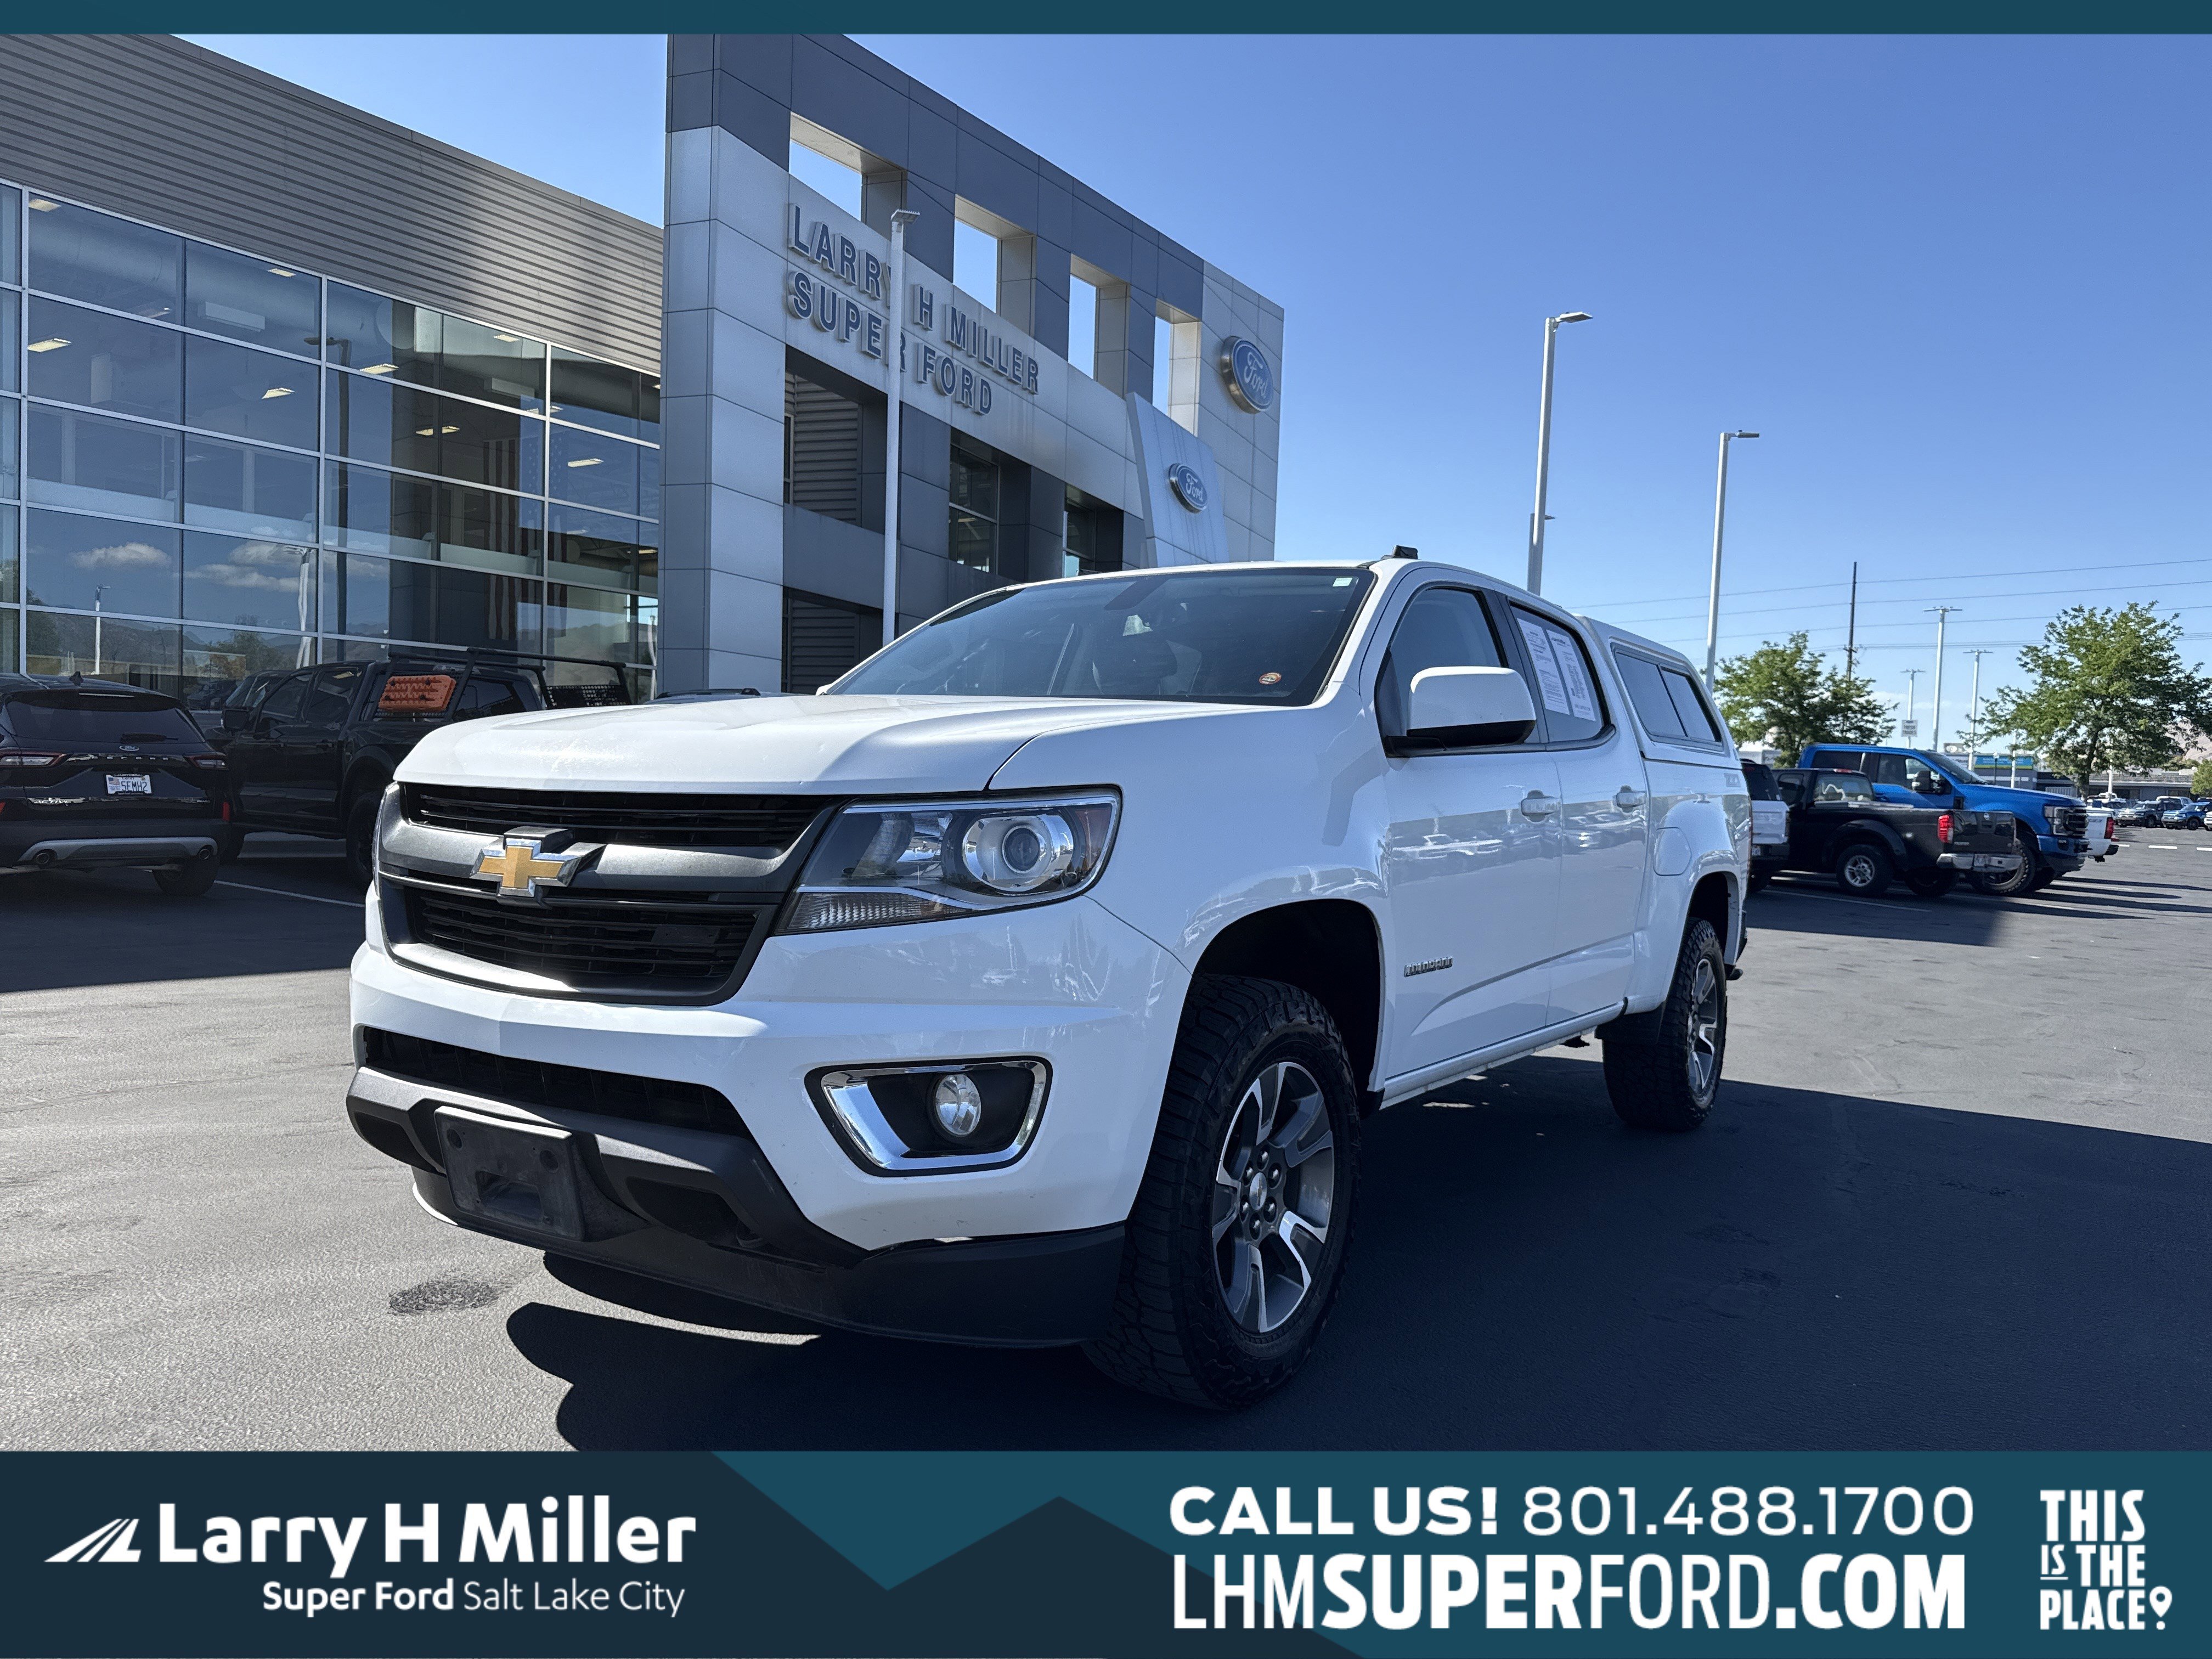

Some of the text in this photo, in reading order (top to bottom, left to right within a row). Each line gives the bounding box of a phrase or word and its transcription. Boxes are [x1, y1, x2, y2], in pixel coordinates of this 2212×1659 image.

[788, 202, 1039, 395] LARR H MILLER
[917, 342, 992, 416] FORD
[1244, 351, 1268, 399] Ford
[1186, 472, 1204, 502] Ford
